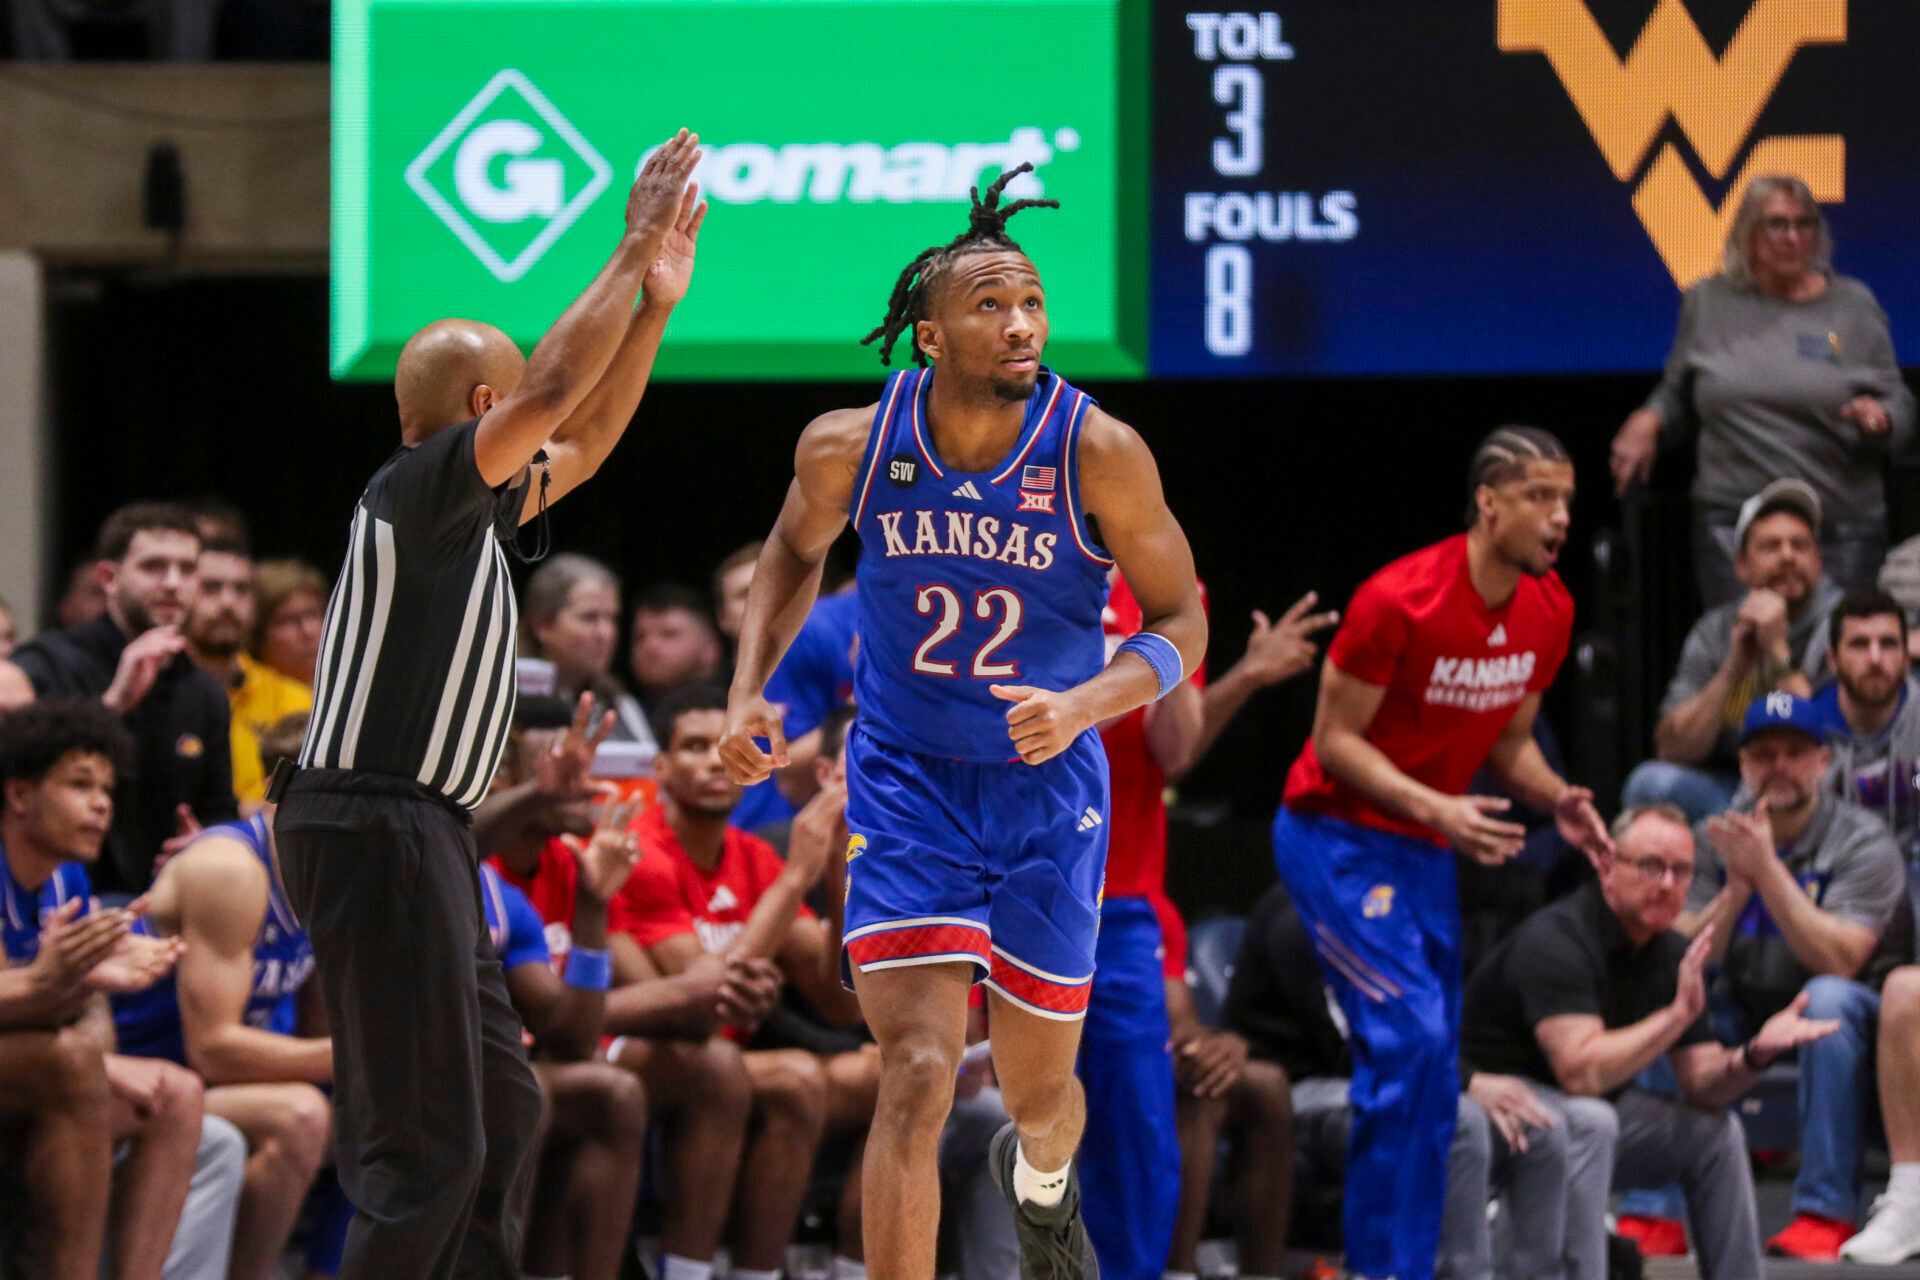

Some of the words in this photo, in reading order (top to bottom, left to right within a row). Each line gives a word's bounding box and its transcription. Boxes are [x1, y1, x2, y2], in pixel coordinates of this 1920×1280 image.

[1187, 14, 1293, 59] TOL
[1213, 66, 1263, 176] 3
[453, 120, 564, 222] G
[634, 126, 1053, 204] omart
[1186, 193, 1359, 241] FOULS
[1205, 246, 1252, 356] 8
[890, 461, 915, 482] SW
[877, 510, 1058, 570] KANSAS
[912, 583, 1025, 677] 22
[1430, 651, 1536, 688] KANSAS
